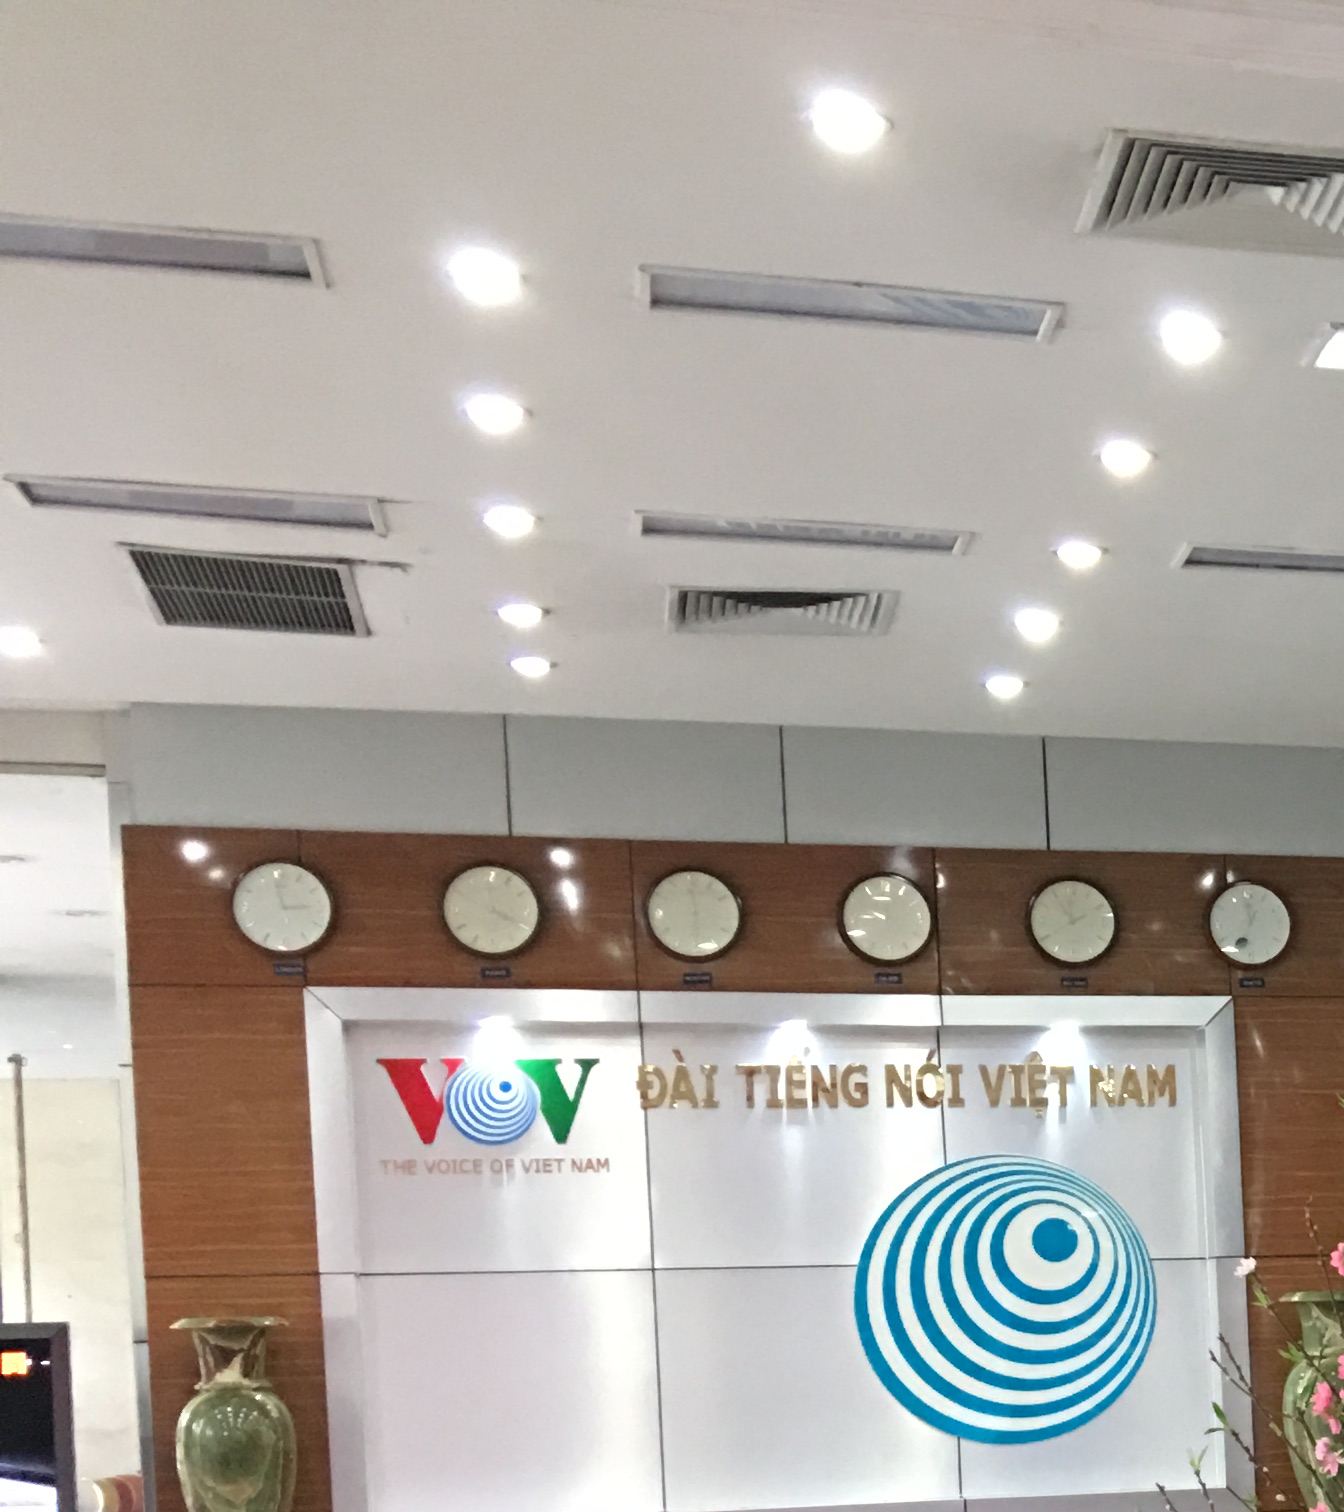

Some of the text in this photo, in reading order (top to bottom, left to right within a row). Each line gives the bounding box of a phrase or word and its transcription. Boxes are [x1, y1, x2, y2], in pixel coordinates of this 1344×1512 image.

[376, 1058, 600, 1145] VOV
[636, 1046, 1178, 1118] ĐÀI TIẾNG NÓI VIỆT NAM
[380, 1157, 610, 1176] THE VOICE OF VIET NAM
